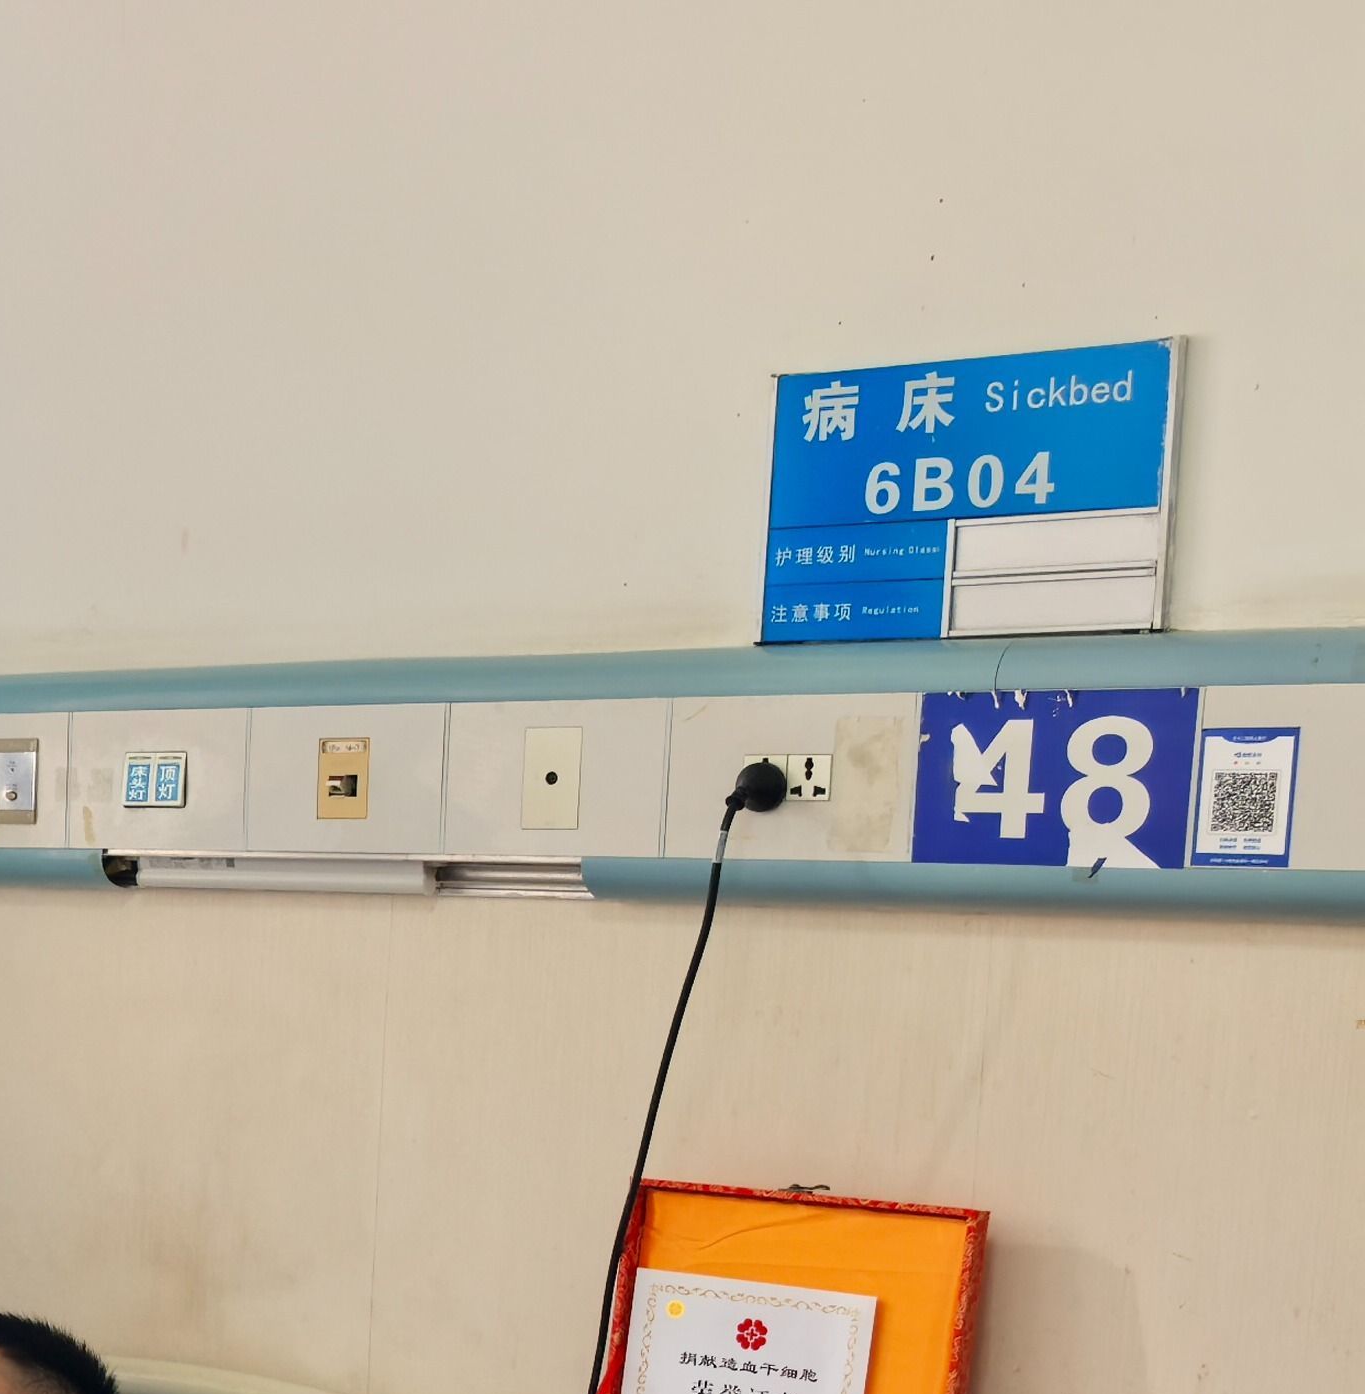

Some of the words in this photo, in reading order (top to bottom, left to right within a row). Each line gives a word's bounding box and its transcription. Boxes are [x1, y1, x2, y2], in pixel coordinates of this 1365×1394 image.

[985, 370, 1134, 413] Sickbed
[865, 451, 1055, 515] 6B04
[775, 543, 856, 567] 护理级别
[770, 603, 853, 623] 注意事项
[157, 765, 178, 800] 顶灯
[952, 714, 1155, 840] 48
[679, 1351, 818, 1383] 捐献造血干细胞
